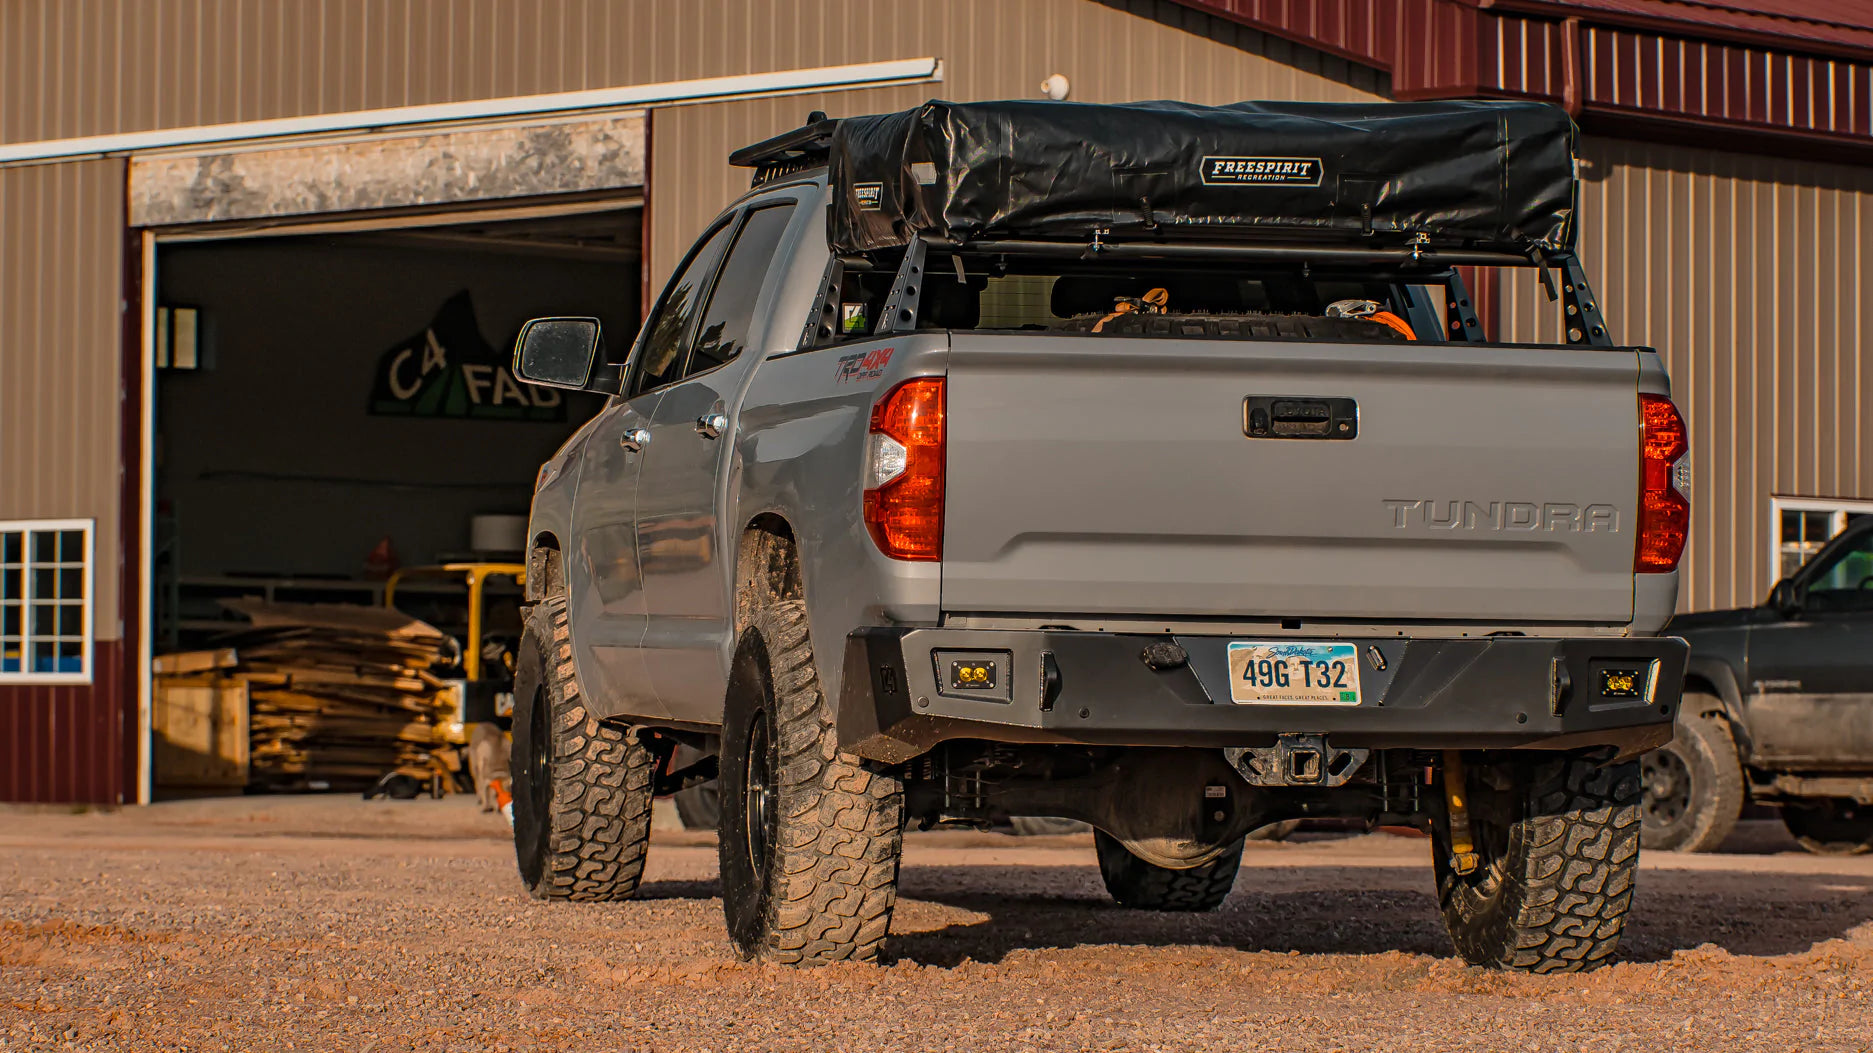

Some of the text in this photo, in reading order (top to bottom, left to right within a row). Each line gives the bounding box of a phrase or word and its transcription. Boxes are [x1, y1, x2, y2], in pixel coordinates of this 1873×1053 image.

[1211, 161, 1312, 176] FREESPIRIT
[834, 352, 867, 384] TRD
[1382, 499, 1620, 532] TUNDRA
[1242, 659, 1348, 688] 49G T32
